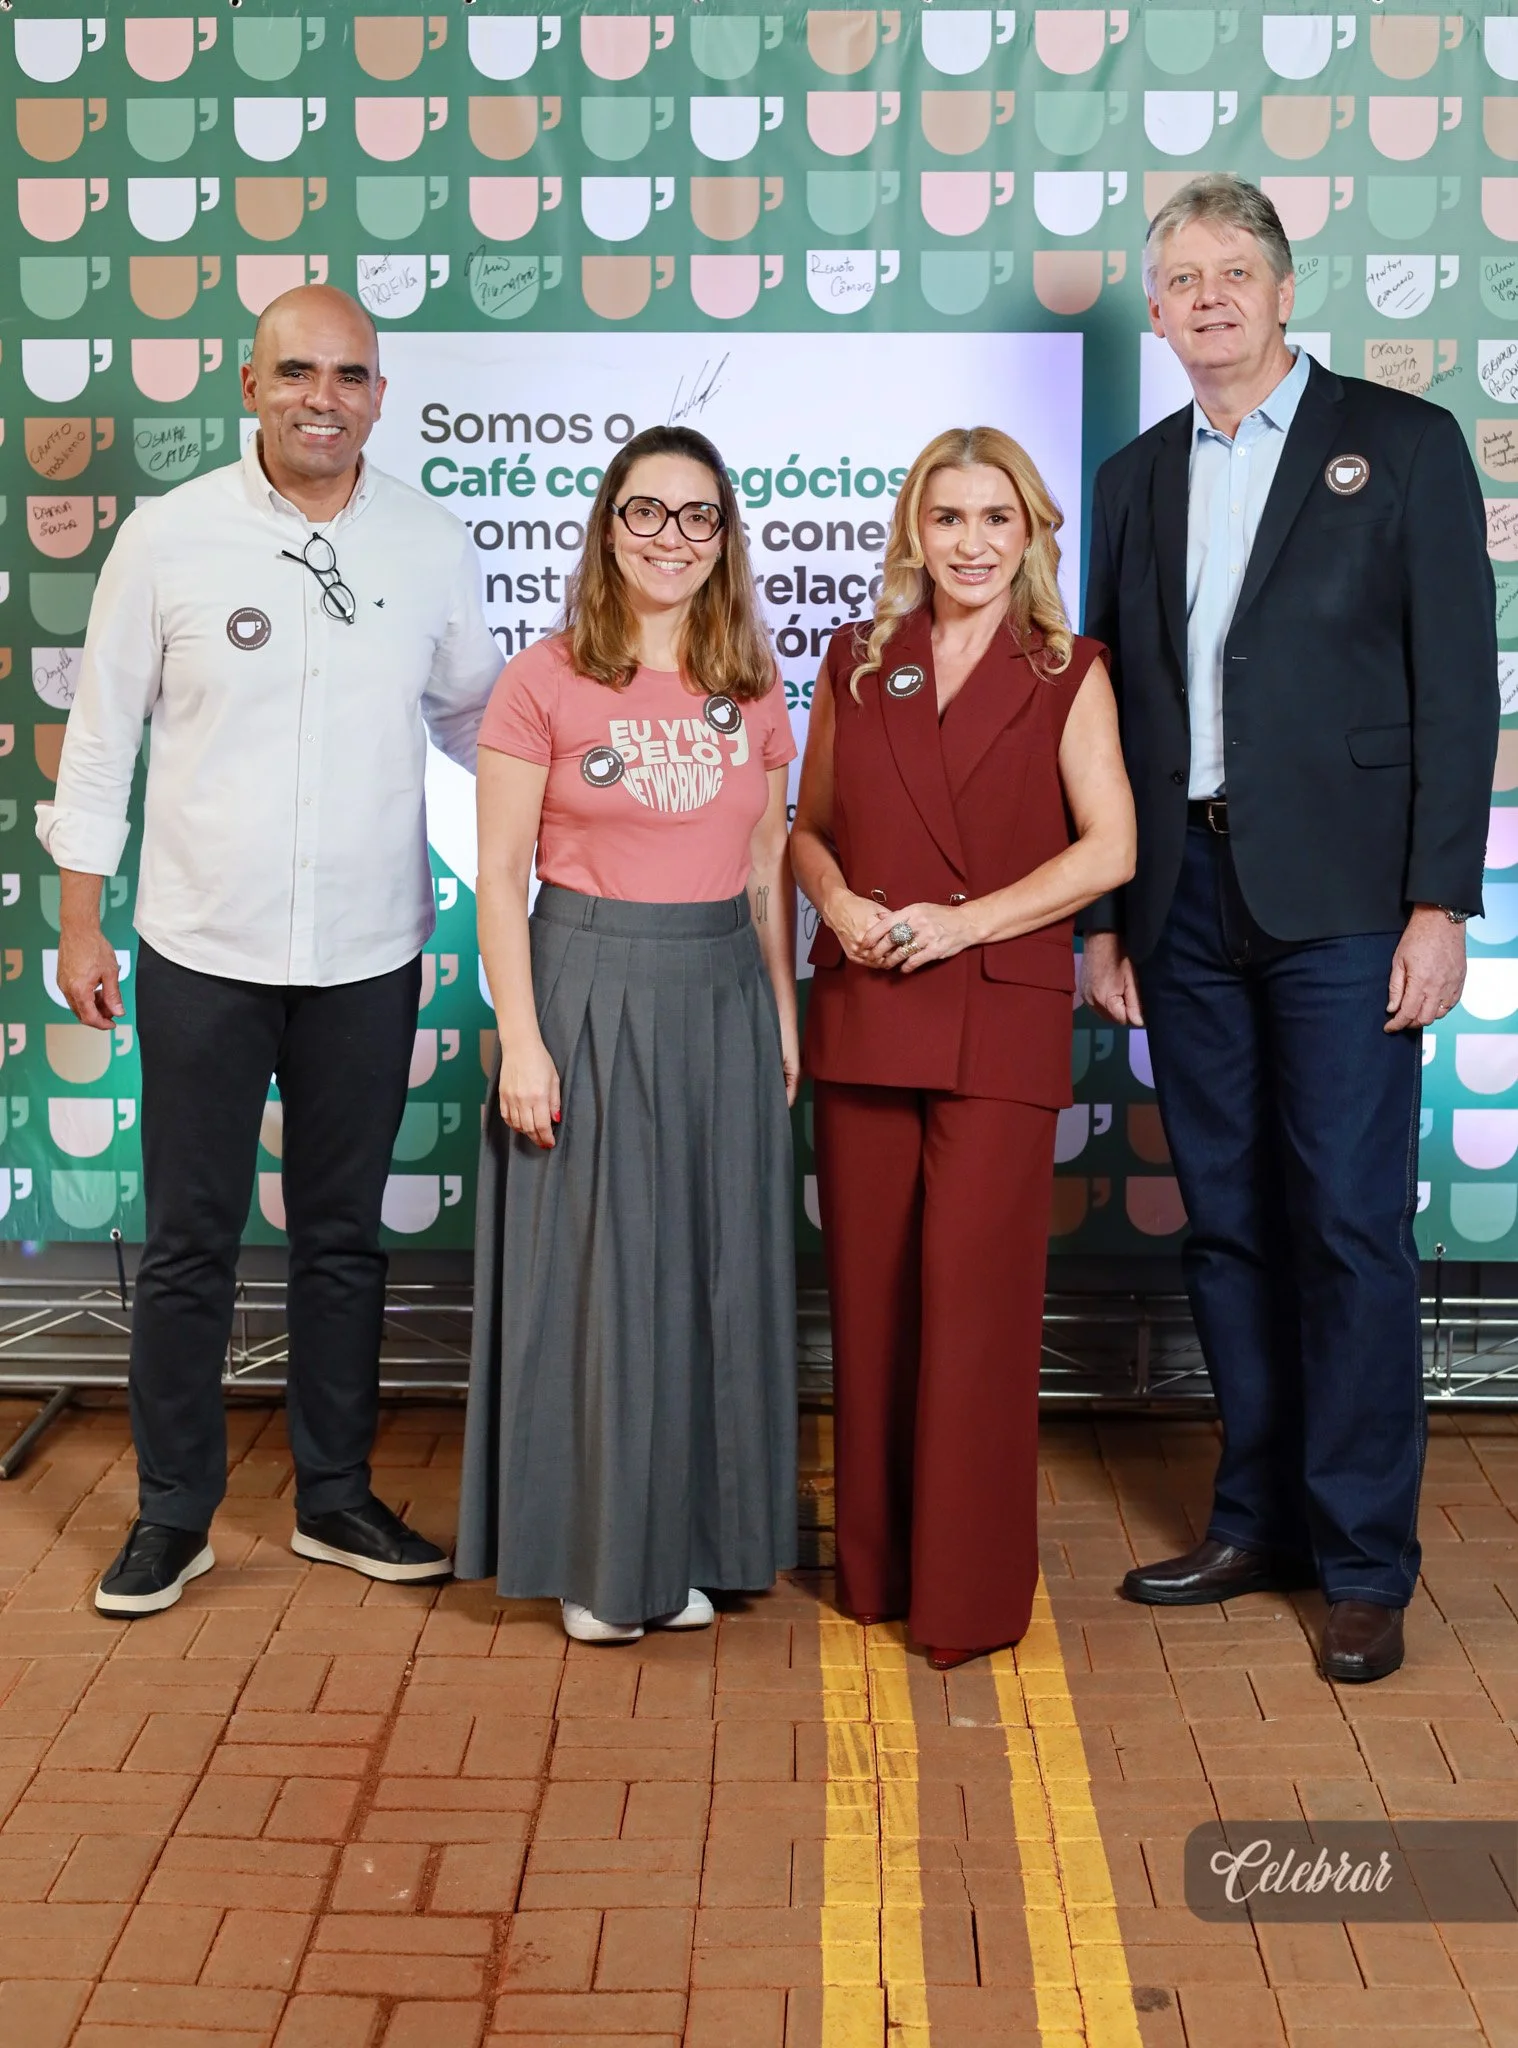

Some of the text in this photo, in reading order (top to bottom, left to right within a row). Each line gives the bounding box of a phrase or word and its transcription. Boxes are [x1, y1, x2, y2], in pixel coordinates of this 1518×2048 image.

[420, 402, 635, 444] Somos o
[421, 453, 536, 498] Café
[546, 466, 606, 498] co
[762, 520, 890, 551] cone
[609, 718, 719, 748] EU VIM
[613, 740, 723, 766] PELO
[620, 762, 724, 814] NETWORKING
